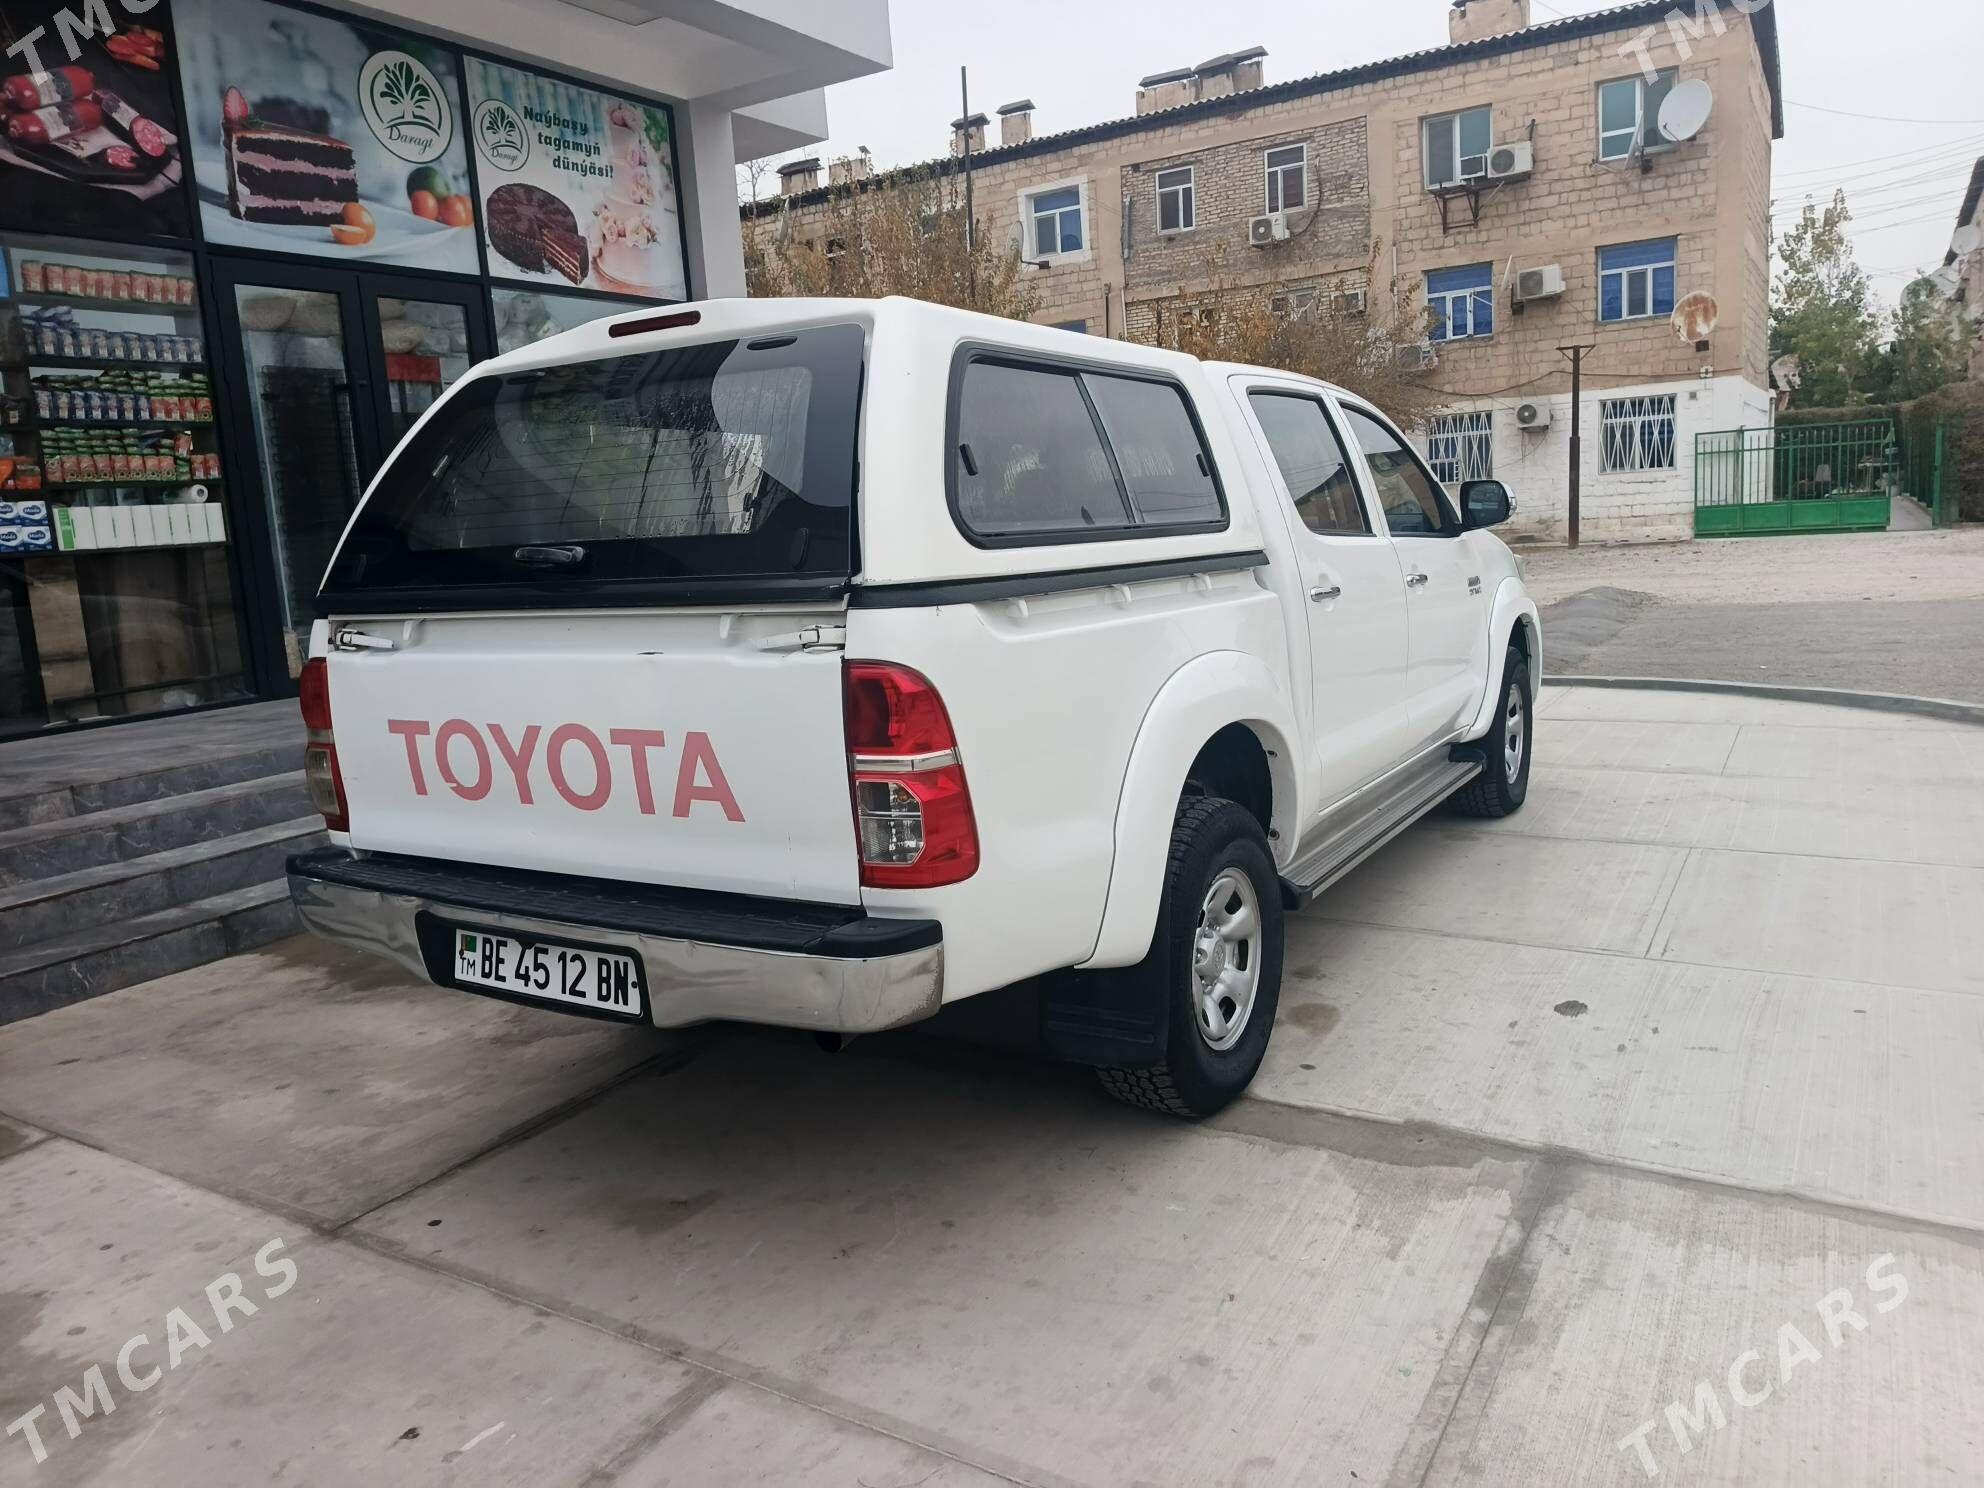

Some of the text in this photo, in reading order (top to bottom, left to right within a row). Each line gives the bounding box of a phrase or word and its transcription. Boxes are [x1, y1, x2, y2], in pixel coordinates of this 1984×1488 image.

[523, 105, 588, 136] Naýbaşy
[387, 125, 434, 155] Daragt
[538, 132, 601, 157] tagamyň
[552, 155, 614, 178] dünýäsi!
[387, 718, 746, 822] TOYOTA
[460, 956, 476, 976] TM
[481, 936, 629, 1006] BE 4512 BN
